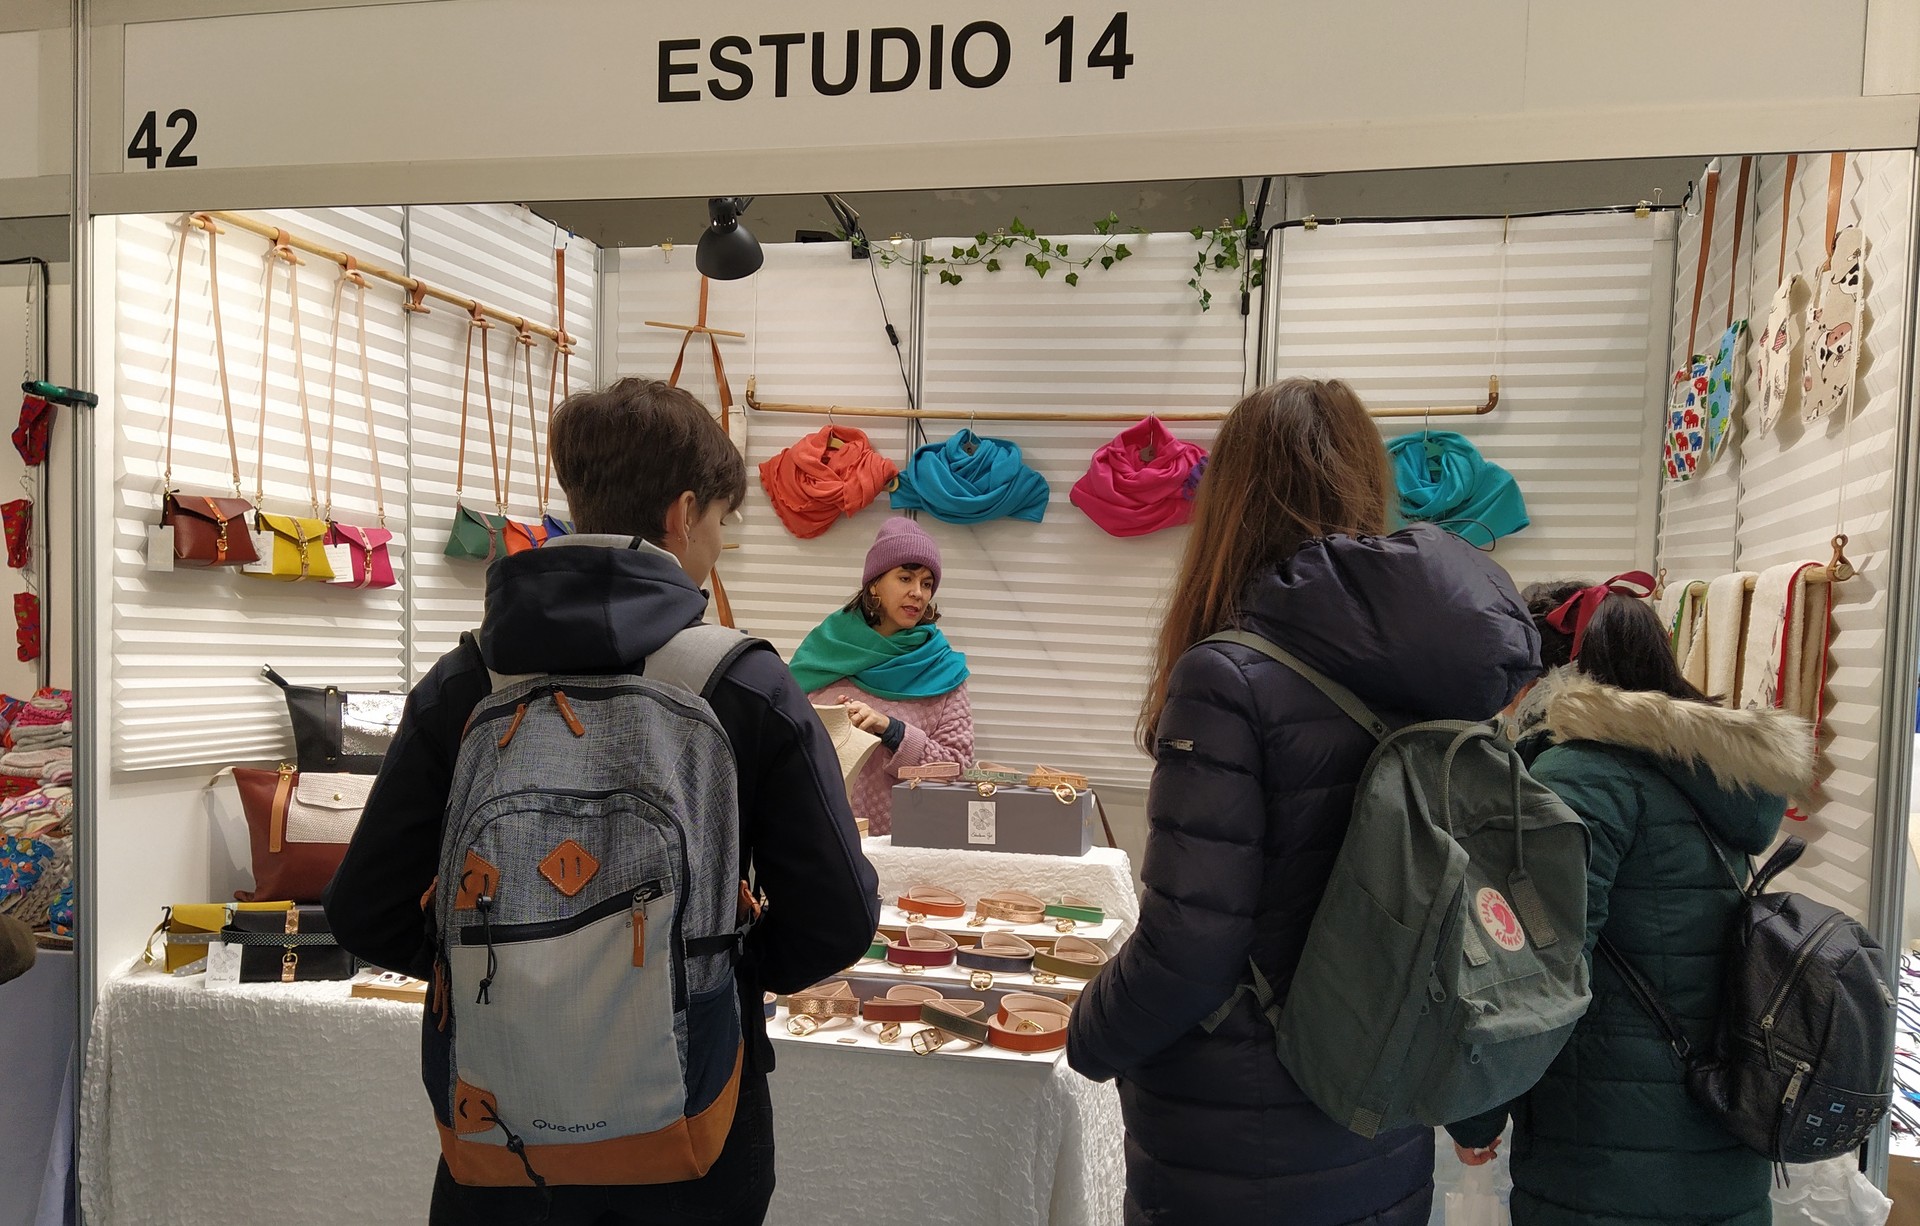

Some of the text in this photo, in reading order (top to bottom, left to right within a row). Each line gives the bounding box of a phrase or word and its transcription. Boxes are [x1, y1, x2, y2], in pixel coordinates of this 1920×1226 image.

[658, 12, 1133, 102] ESTUDIO 14
[128, 109, 197, 169] 42
[532, 1119, 607, 1133] Quechua
